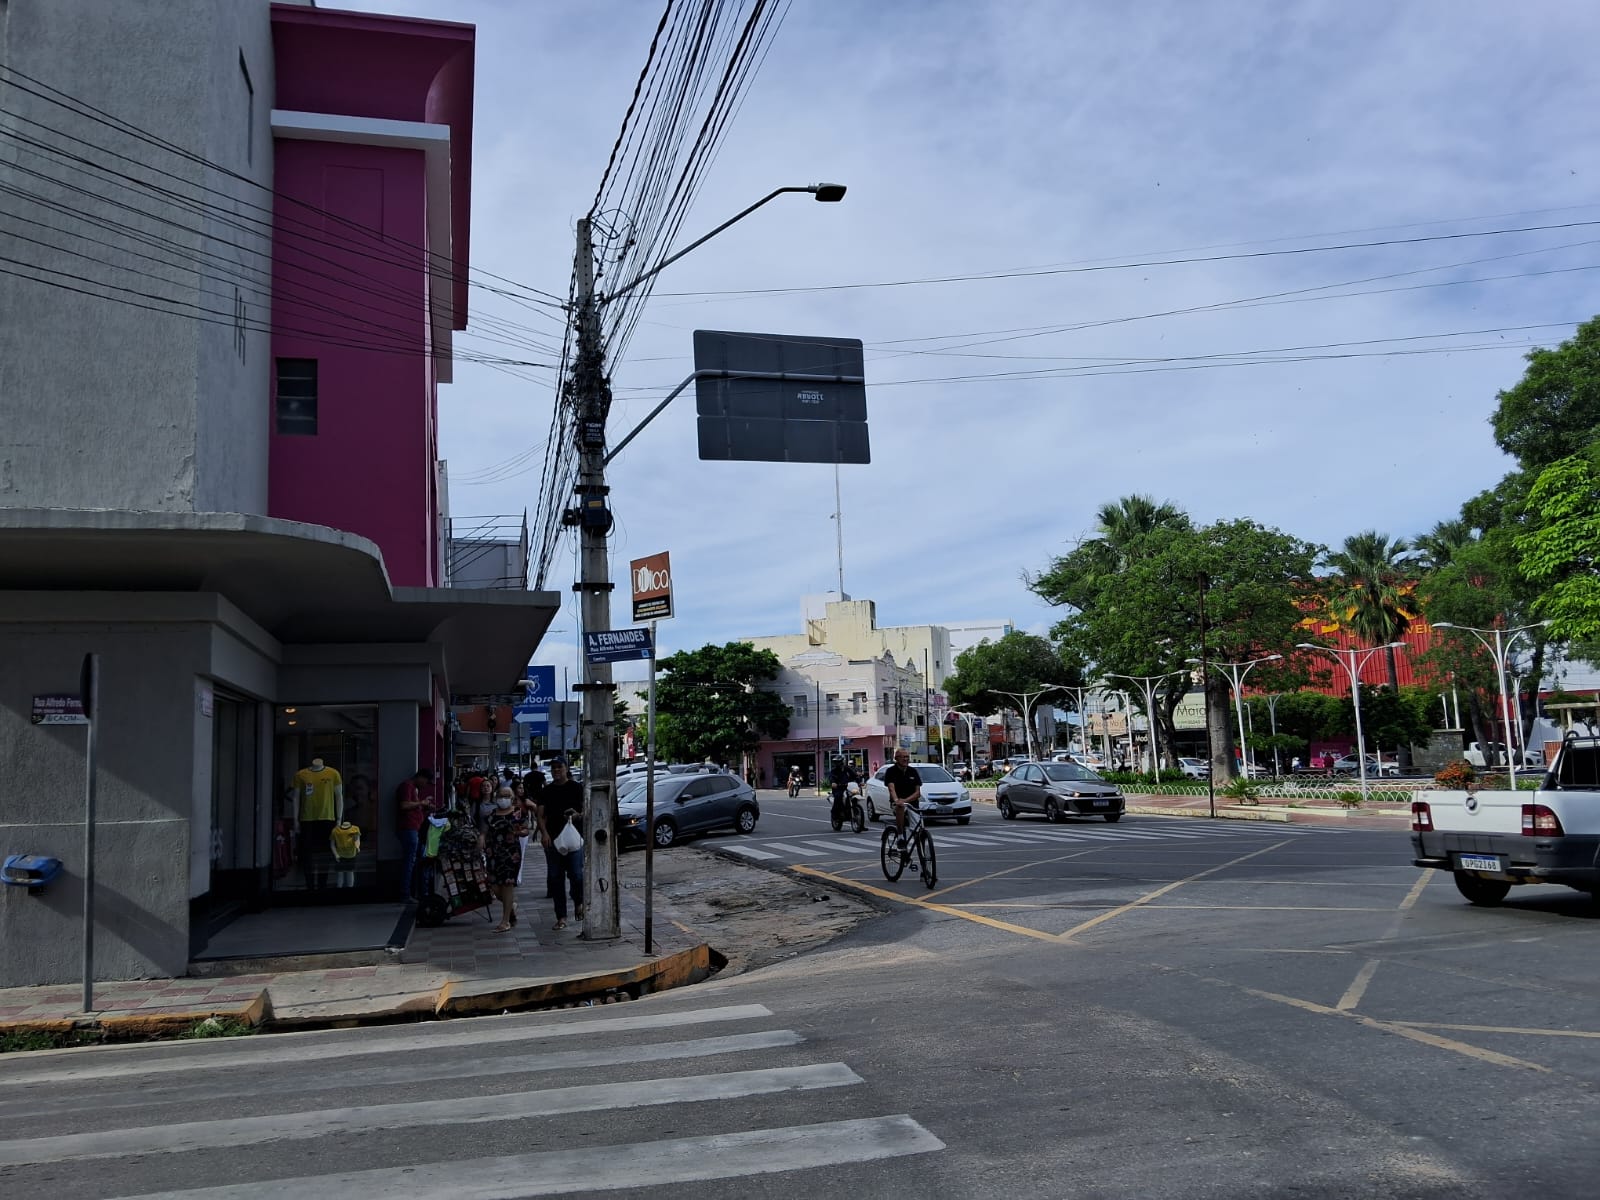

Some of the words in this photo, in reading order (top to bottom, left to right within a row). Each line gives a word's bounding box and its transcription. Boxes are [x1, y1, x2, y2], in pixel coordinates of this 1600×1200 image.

[589, 634, 598, 646] A.
[597, 630, 644, 645] FERNANDES
[34, 697, 45, 707] Rua
[46, 697, 65, 707] Alfredo
